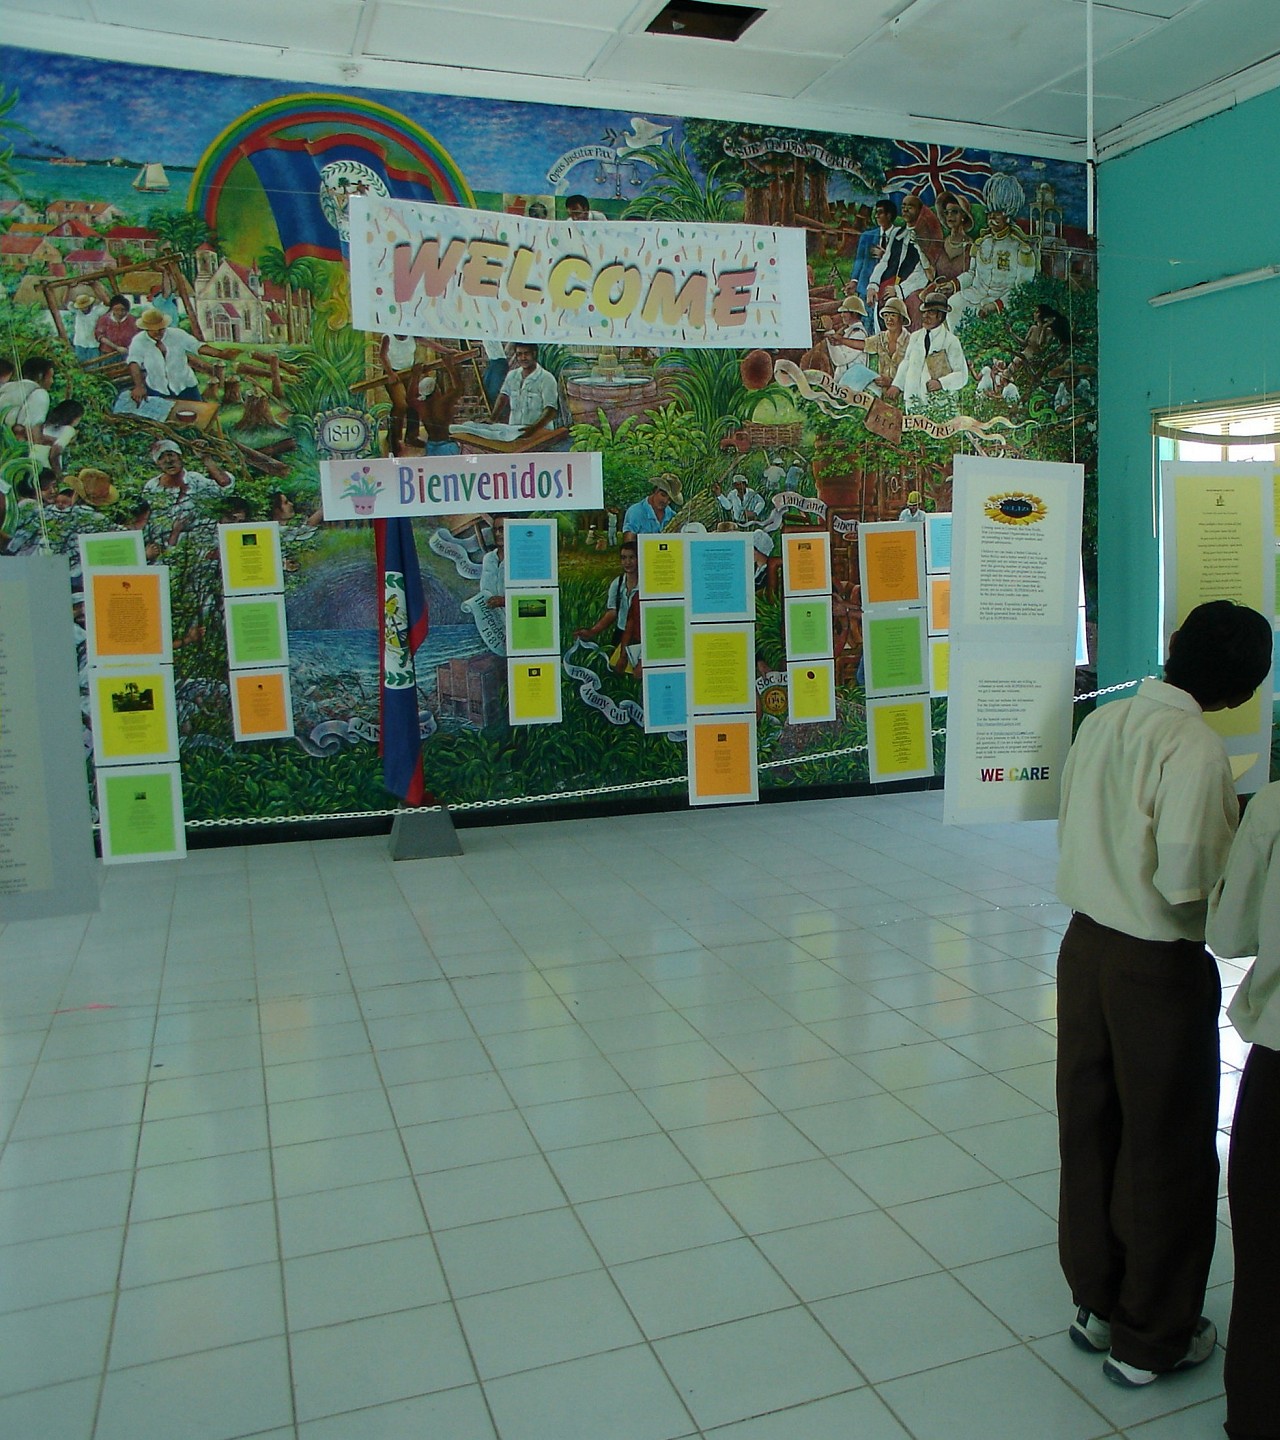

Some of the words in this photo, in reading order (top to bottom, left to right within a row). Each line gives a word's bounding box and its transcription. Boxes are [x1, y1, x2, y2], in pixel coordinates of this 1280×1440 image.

[595, 147, 612, 159] Pax
[393, 238, 757, 327] WELCOME
[819, 374, 848, 399] DAYS
[853, 392, 870, 407] OF
[904, 418, 955, 437] EMPIRE
[327, 425, 361, 443] 1849
[399, 462, 573, 505] Bienvenidos!
[806, 501, 824, 513] and
[482, 627, 500, 648] 1981
[981, 768, 1004, 782] WE
[1008, 767, 1049, 782] CARE
